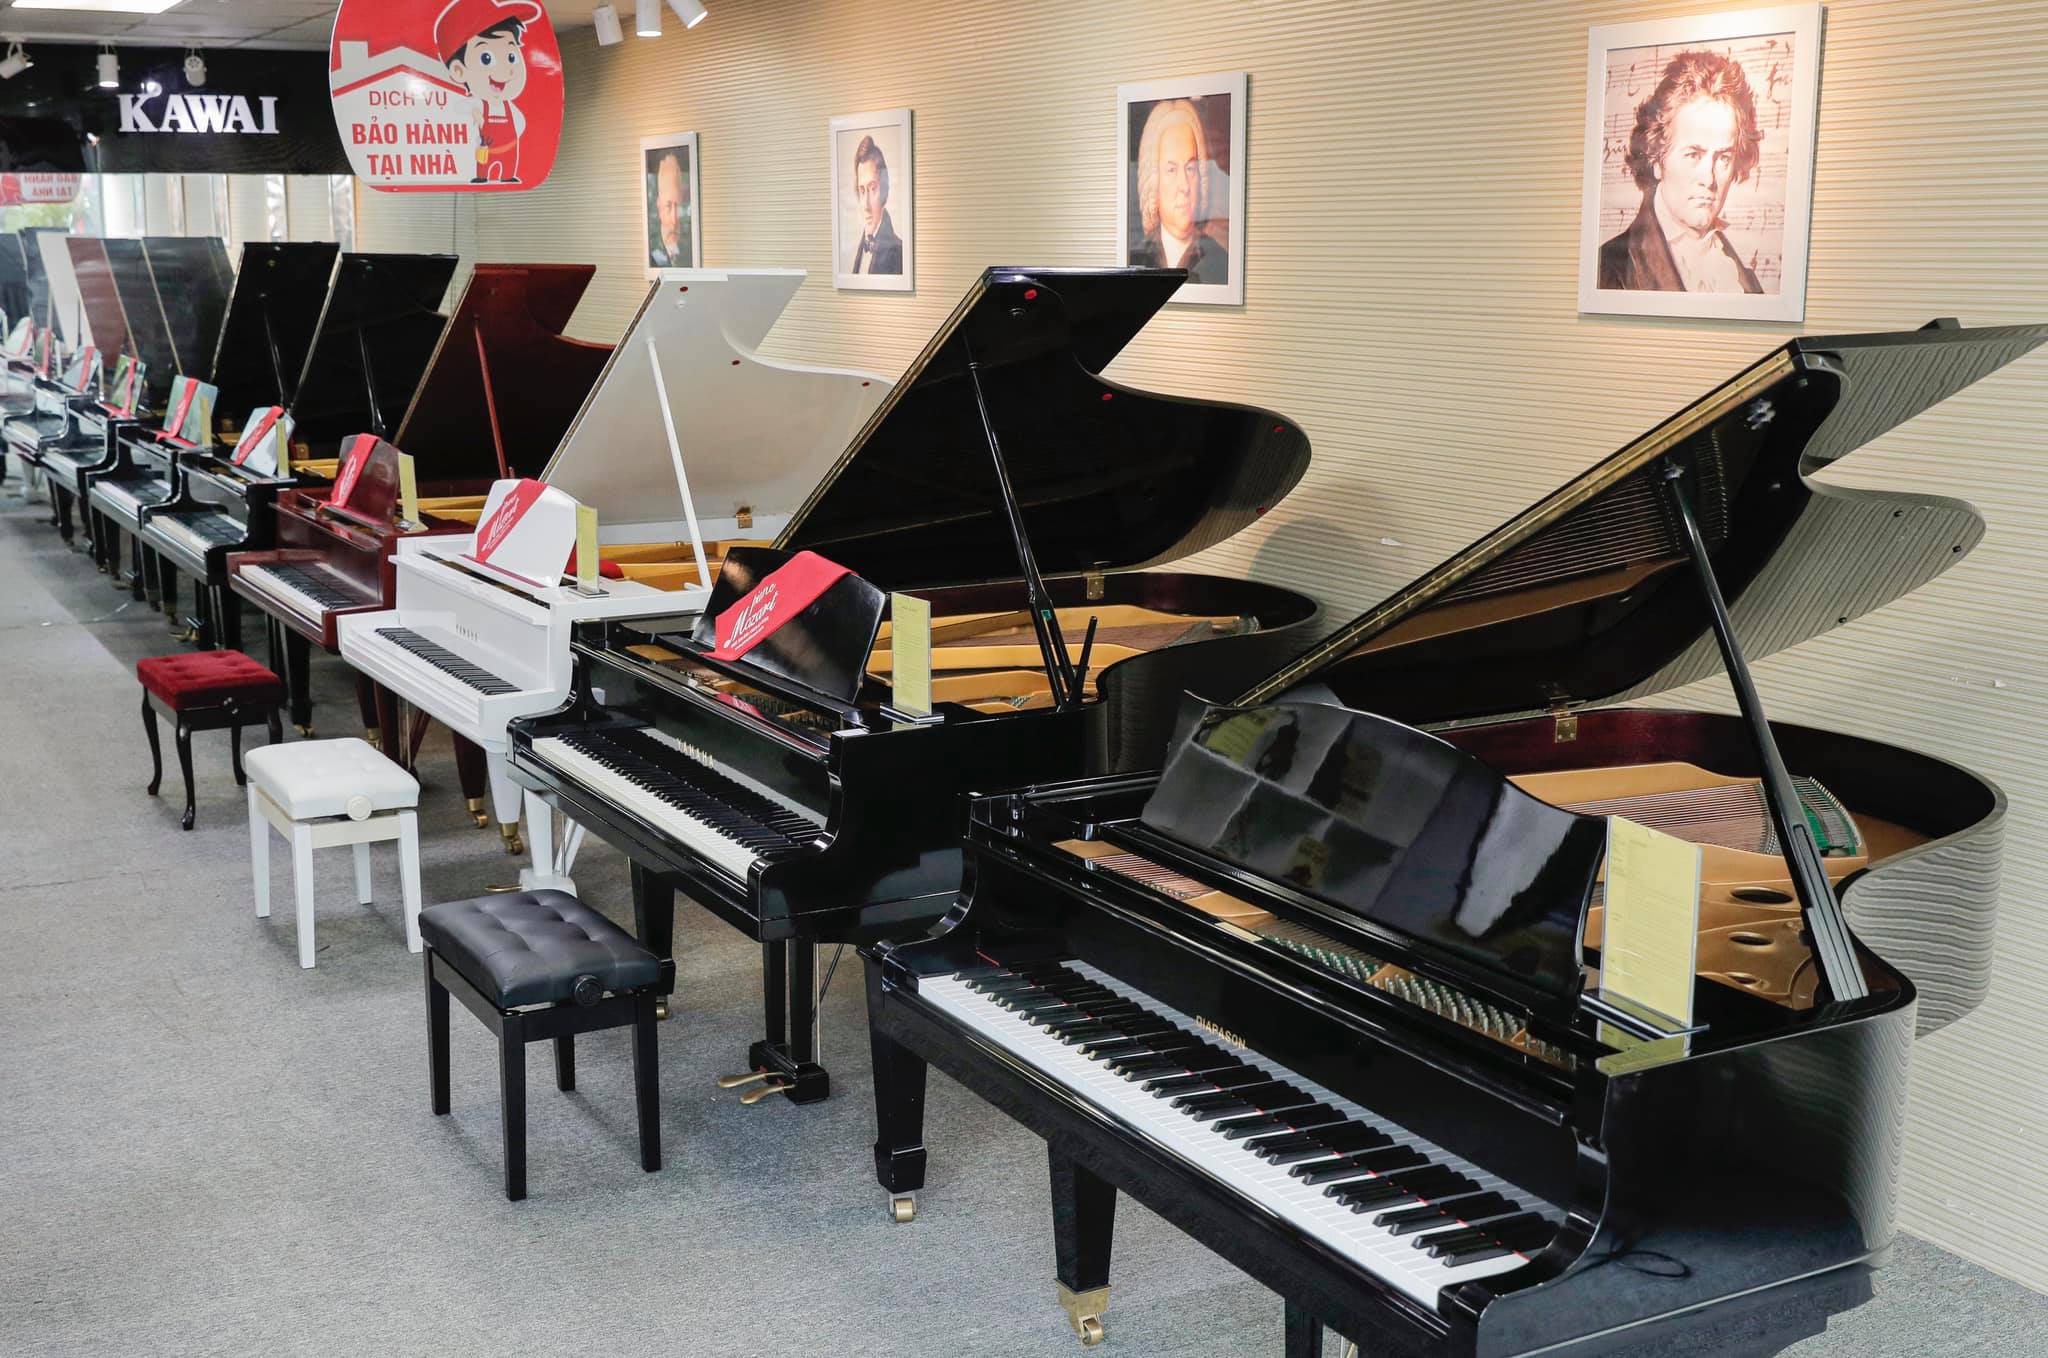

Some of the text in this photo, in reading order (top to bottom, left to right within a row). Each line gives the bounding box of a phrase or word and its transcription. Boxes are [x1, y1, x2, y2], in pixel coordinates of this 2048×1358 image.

[117, 93, 280, 134] KAWAI
[369, 90, 447, 110] DỊCH VỤ
[352, 115, 468, 145] BẢO HÀNH
[366, 149, 458, 180] TẠI NHÀ
[1195, 1014, 1247, 1050] DIAPASON
